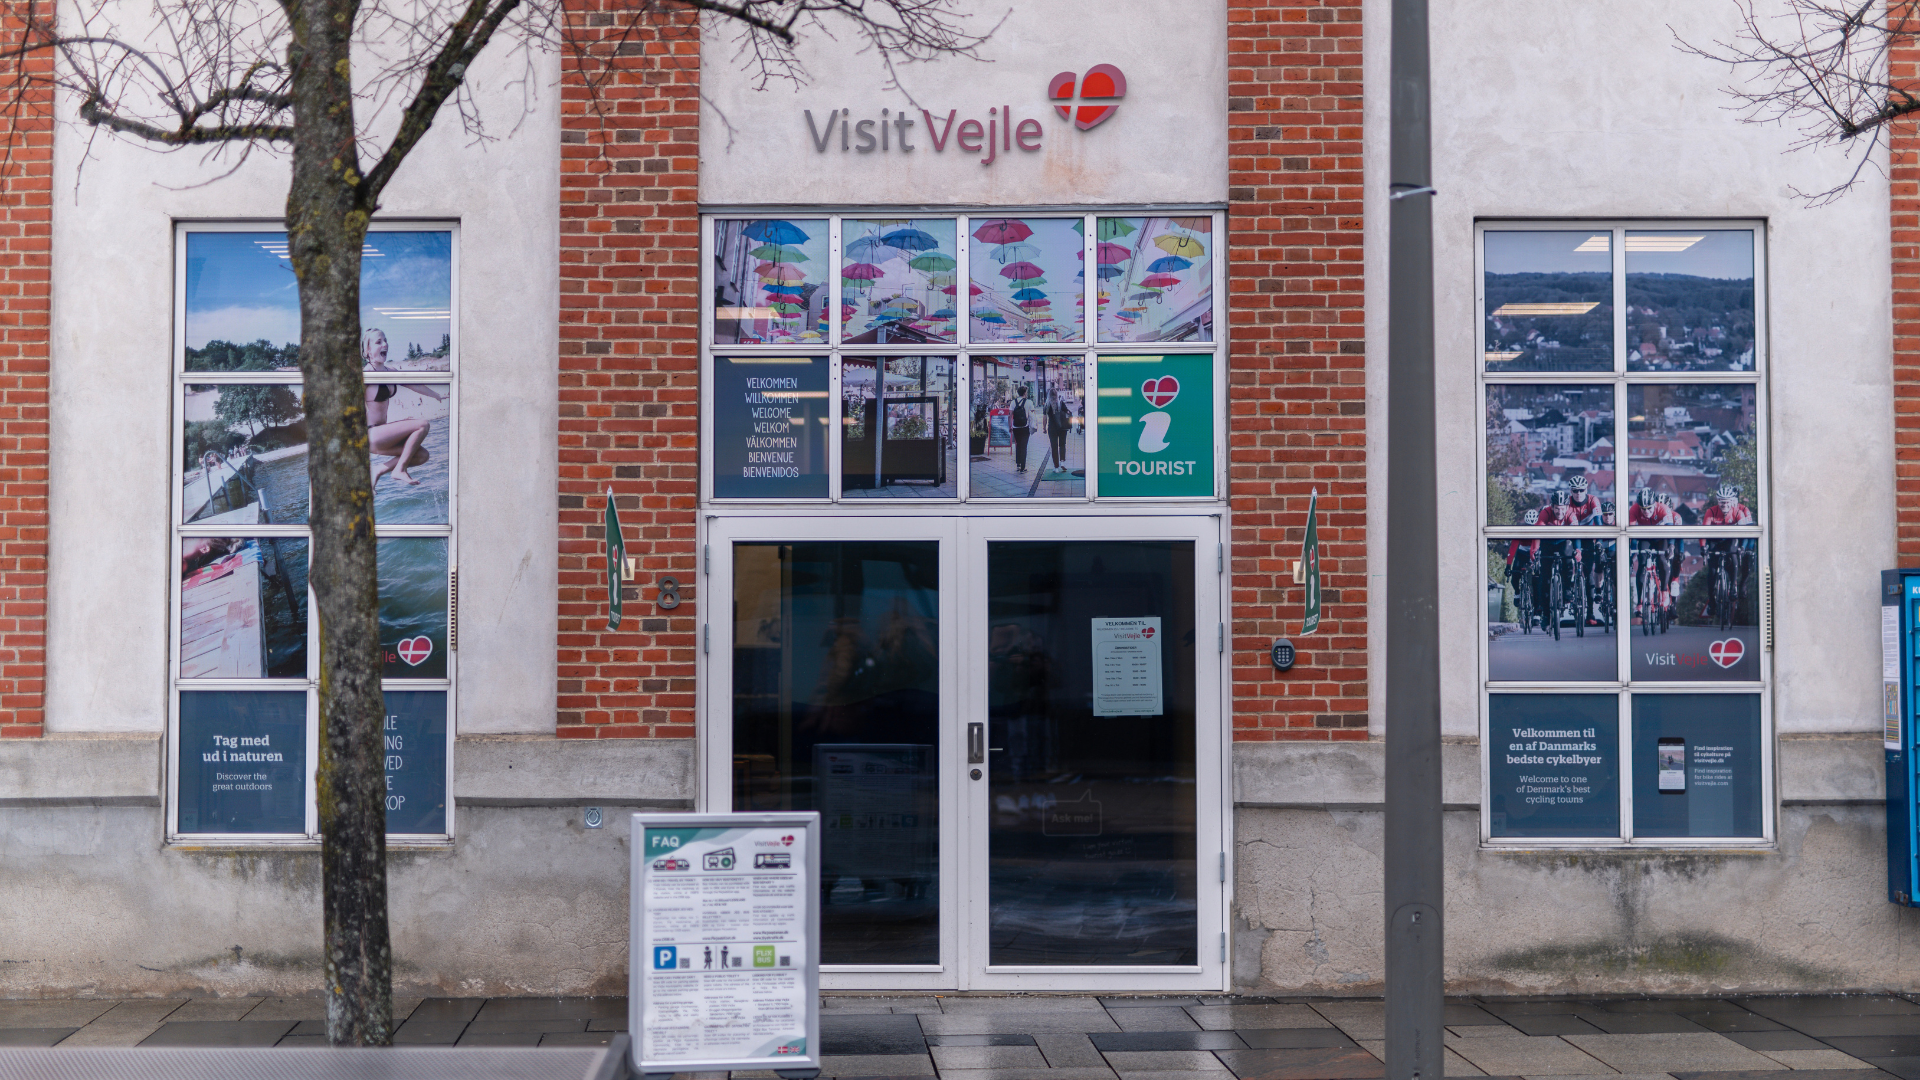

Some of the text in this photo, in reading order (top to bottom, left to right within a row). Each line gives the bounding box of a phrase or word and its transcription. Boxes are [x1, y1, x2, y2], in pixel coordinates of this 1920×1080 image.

[746, 378, 798, 388] VELKOMMEN
[745, 393, 799, 403] WILLKOMMEN
[752, 408, 791, 418] WELCOME
[754, 422, 789, 433] WELKOM
[746, 435, 797, 448] VÄLKOMMEN
[748, 452, 794, 462] BIENVENUE
[743, 467, 799, 477] BIENVENIDOS
[1115, 461, 1196, 475] TOURIST
[657, 576, 680, 609] 8
[1512, 728, 1595, 738] Velkommen til
[213, 735, 270, 748] Tag med
[1509, 742, 1596, 751] en af Danmarks
[203, 751, 283, 761] ud i naturen
[1506, 755, 1602, 766] bedste cykelbyer
[1519, 775, 1558, 783] Welcome
[212, 783, 233, 792] great
[1526, 796, 1555, 805] cycling
[1052, 814, 1071, 823] Ask
[652, 837, 679, 847] FAQ
[660, 950, 672, 967] P
